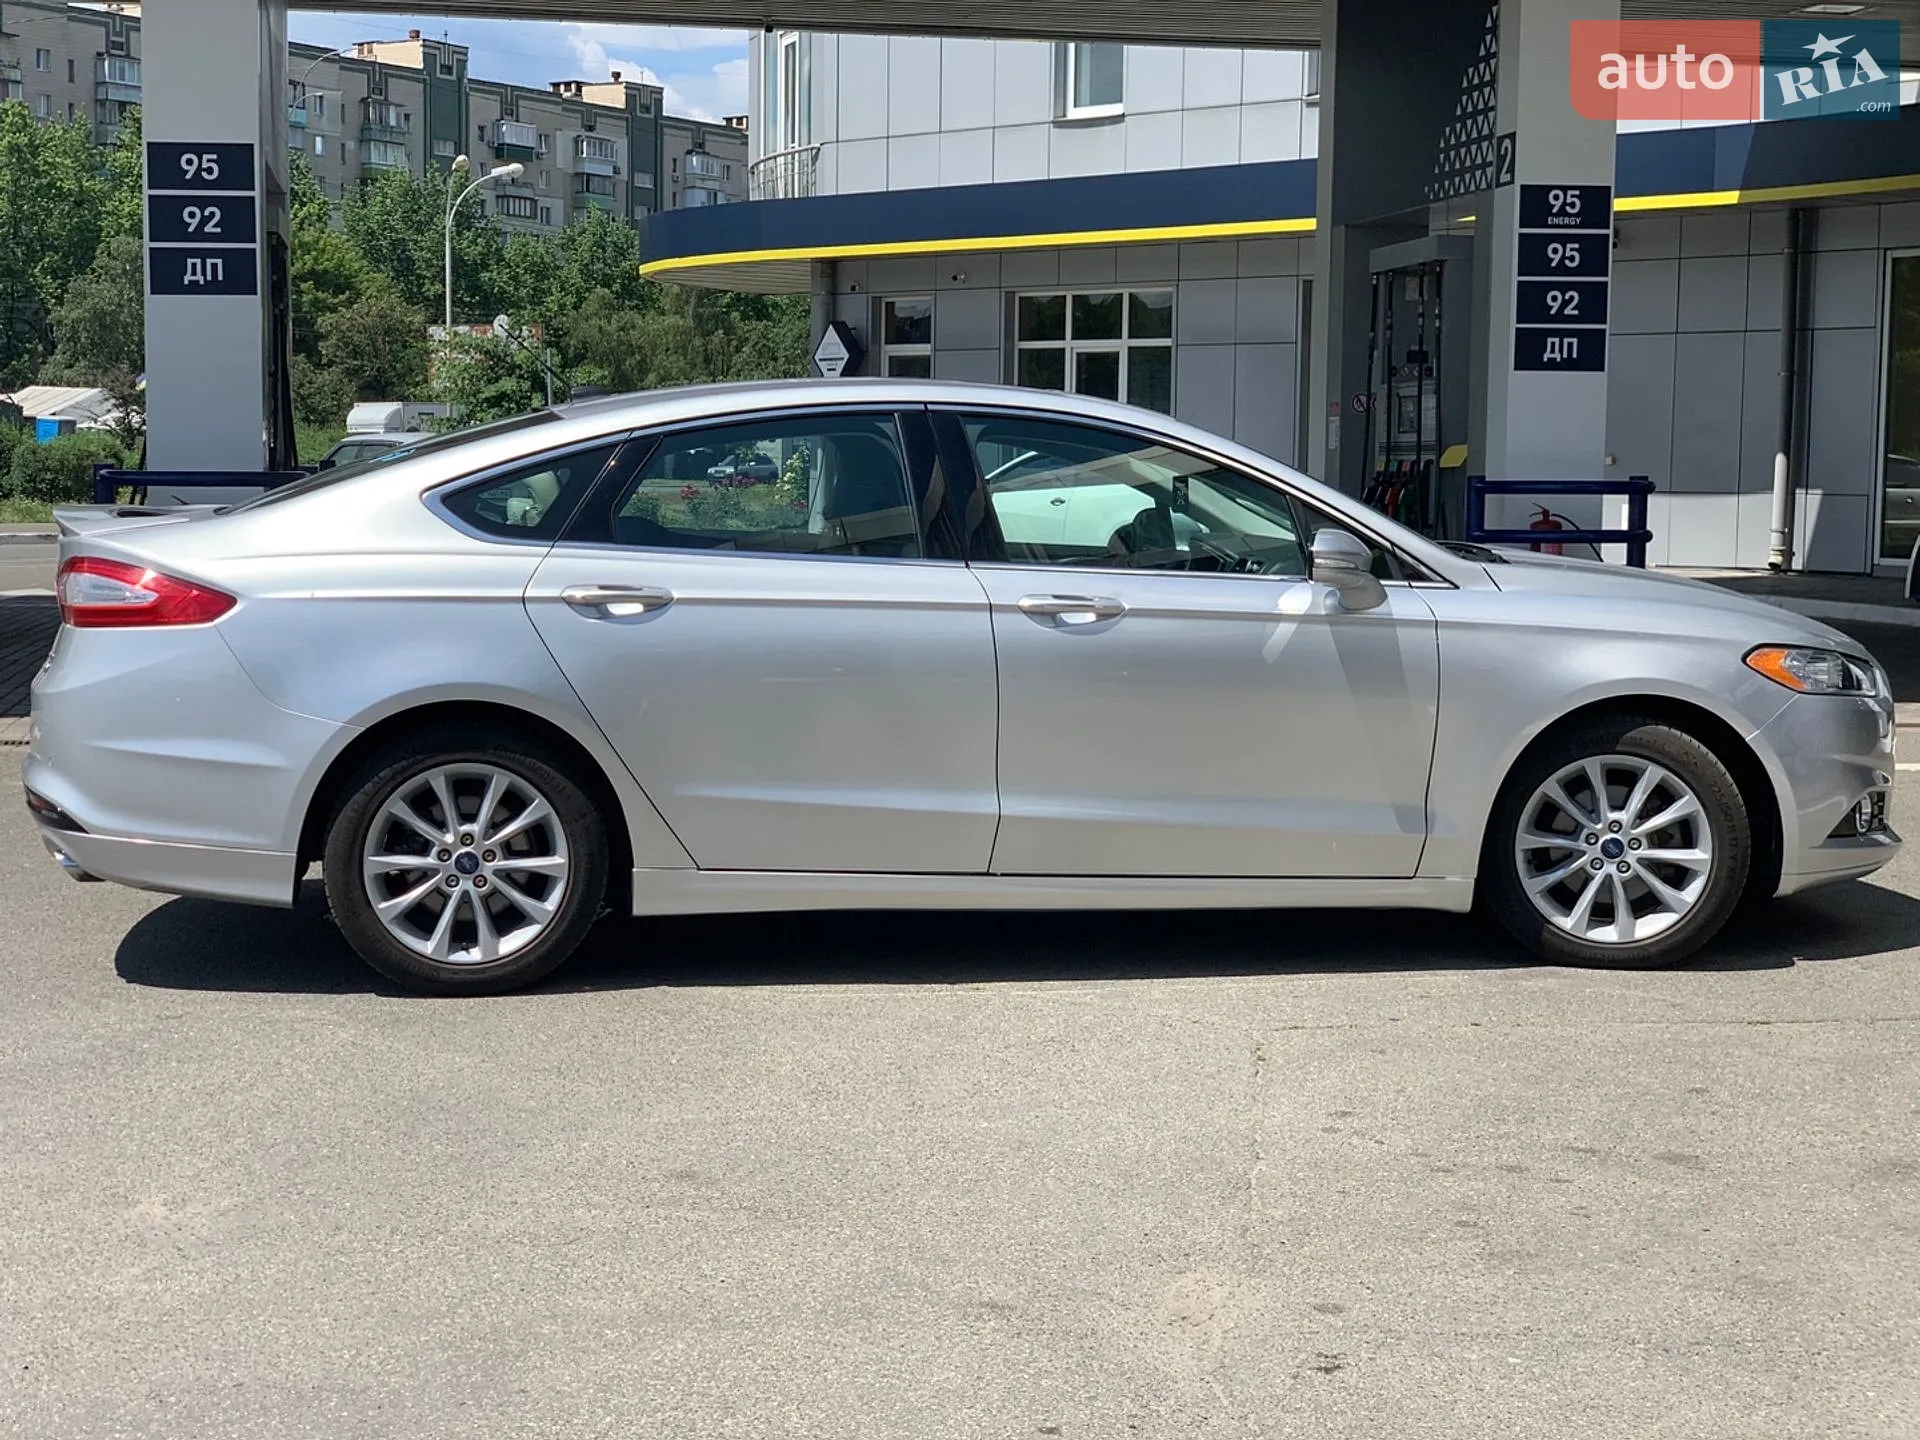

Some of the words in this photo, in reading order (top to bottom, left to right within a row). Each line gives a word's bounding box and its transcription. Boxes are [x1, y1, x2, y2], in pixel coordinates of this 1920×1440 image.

[180, 152, 219, 180] 95
[1499, 138, 1512, 182] 2
[1548, 189, 1581, 214] 95
[182, 206, 222, 233] 92
[1547, 216, 1581, 225] ENERGY
[1547, 242, 1580, 268] 95
[183, 258, 223, 285] ДП
[1546, 290, 1580, 315] 92
[1543, 337, 1578, 362] ДП
